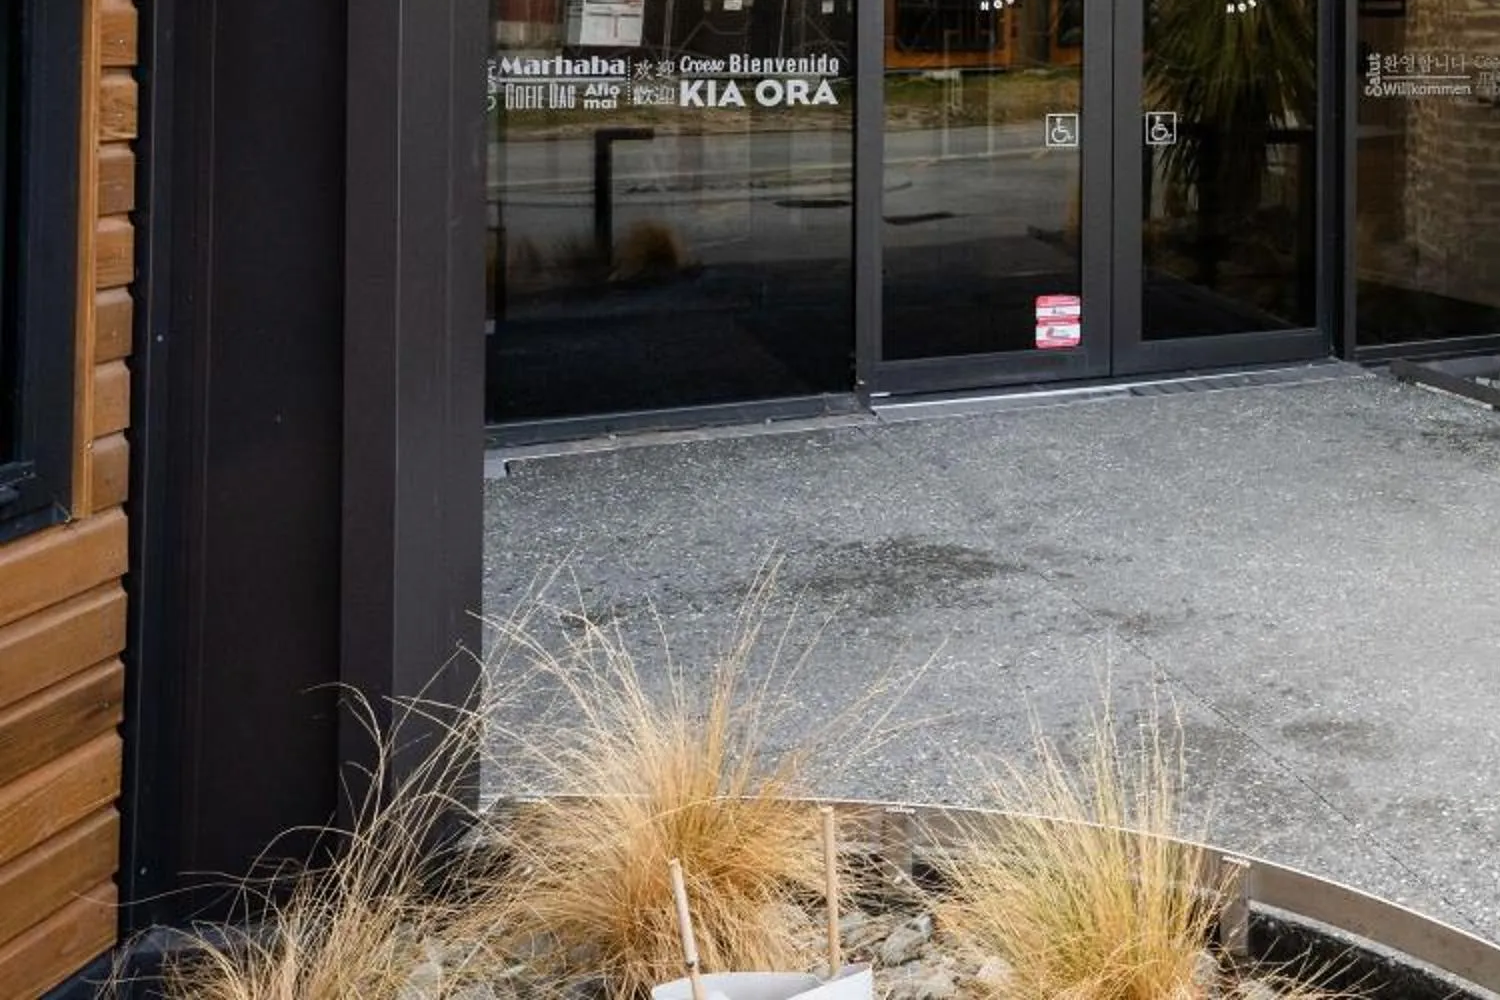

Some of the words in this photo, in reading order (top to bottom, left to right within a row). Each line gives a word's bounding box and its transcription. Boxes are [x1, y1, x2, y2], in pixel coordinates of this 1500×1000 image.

[499, 56, 626, 76] Marhaba
[679, 55, 725, 73] Croeso
[729, 53, 839, 74] Bienvenido
[1365, 53, 1382, 97] Salut
[679, 79, 747, 107] KIA
[755, 78, 839, 107] ORA
[1382, 81, 1472, 96] Willkommen
[583, 97, 618, 110] mai
